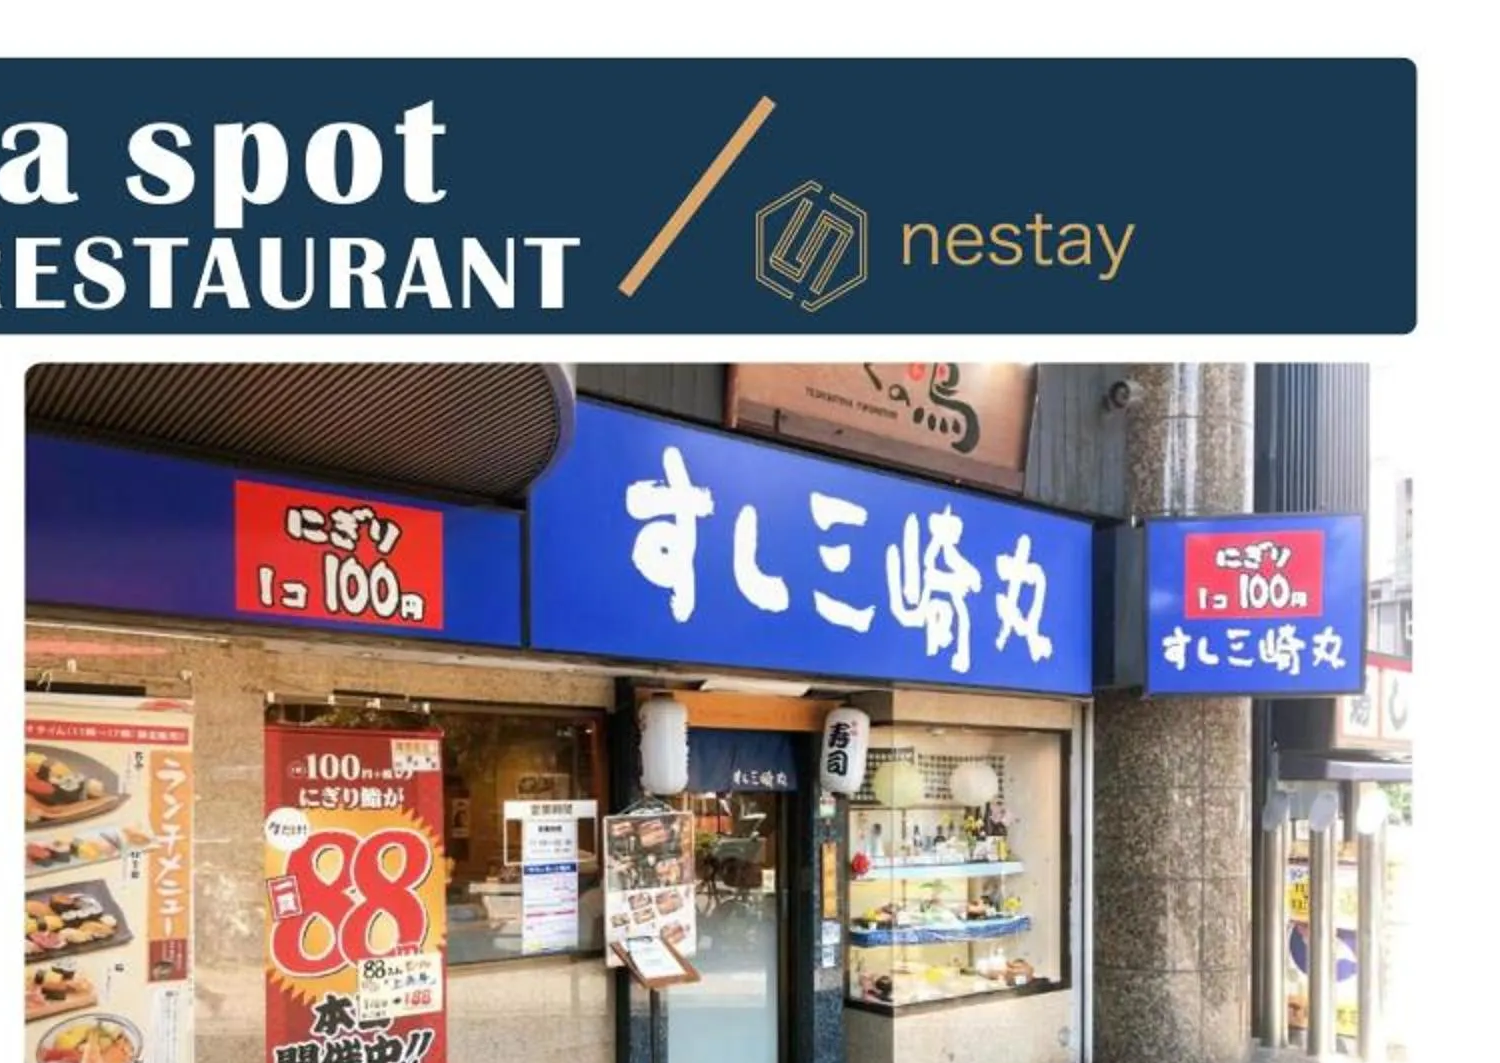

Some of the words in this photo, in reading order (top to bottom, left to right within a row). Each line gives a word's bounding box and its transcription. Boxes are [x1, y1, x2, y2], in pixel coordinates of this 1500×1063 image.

[286, 507, 401, 553] にぎり
[1216, 541, 1291, 569] にぎり
[322, 554, 424, 620] 100円
[626, 446, 1052, 673] すし三崎丸
[1239, 574, 1308, 608] 100円
[1162, 623, 1347, 675] すし三崎丸
[827, 722, 852, 777] 寿司
[154, 757, 188, 937] ランチメニュー
[270, 827, 432, 977] 88
